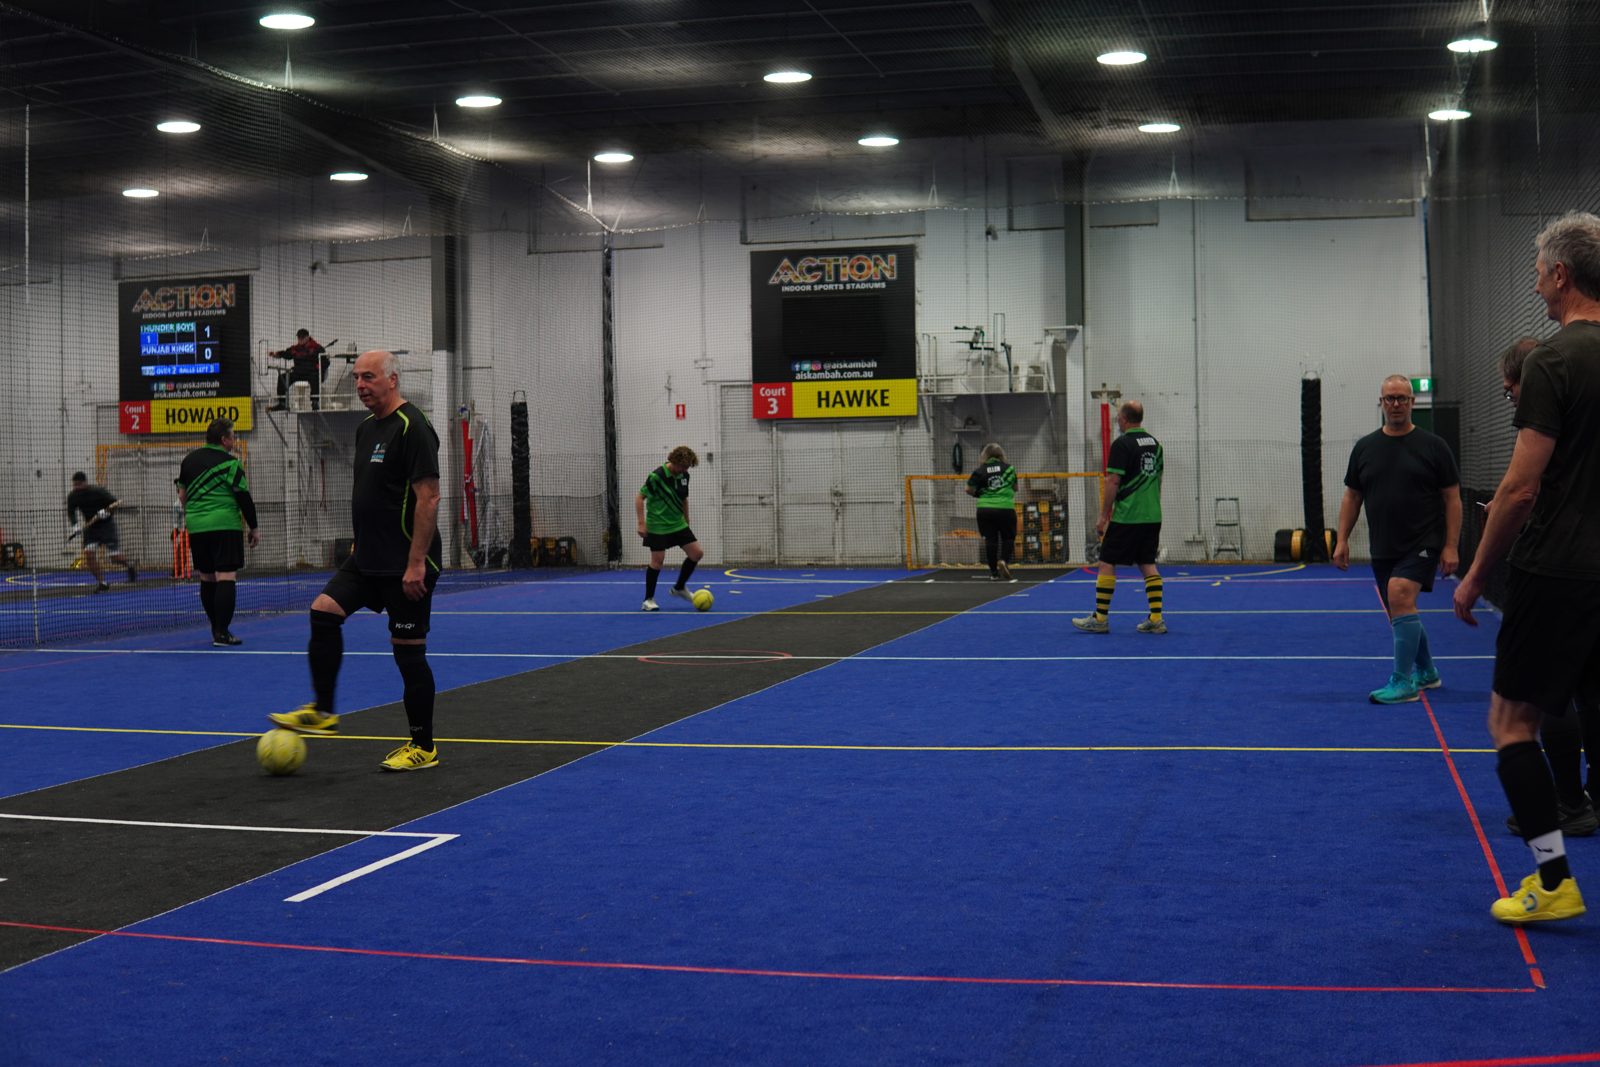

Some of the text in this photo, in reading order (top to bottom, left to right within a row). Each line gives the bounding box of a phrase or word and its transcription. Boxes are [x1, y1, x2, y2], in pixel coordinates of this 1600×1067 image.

[768, 254, 897, 284] ACTION
[781, 281, 886, 292] INDOOR SPORTS STADIUMS
[132, 283, 236, 313] ACTION
[176, 322, 194, 332] BOYS
[204, 325, 210, 338] 1
[141, 343, 194, 354] PUNJAB KINGS
[204, 347, 212, 360] 0
[823, 359, 877, 370] @aiskambah
[795, 370, 874, 380] aiskambah.com.au
[759, 386, 786, 397] Court
[817, 389, 890, 408] HAWKE
[124, 405, 146, 414] Court
[767, 398, 779, 415] 3
[165, 406, 240, 425] HOWARD
[131, 415, 140, 430] 2
